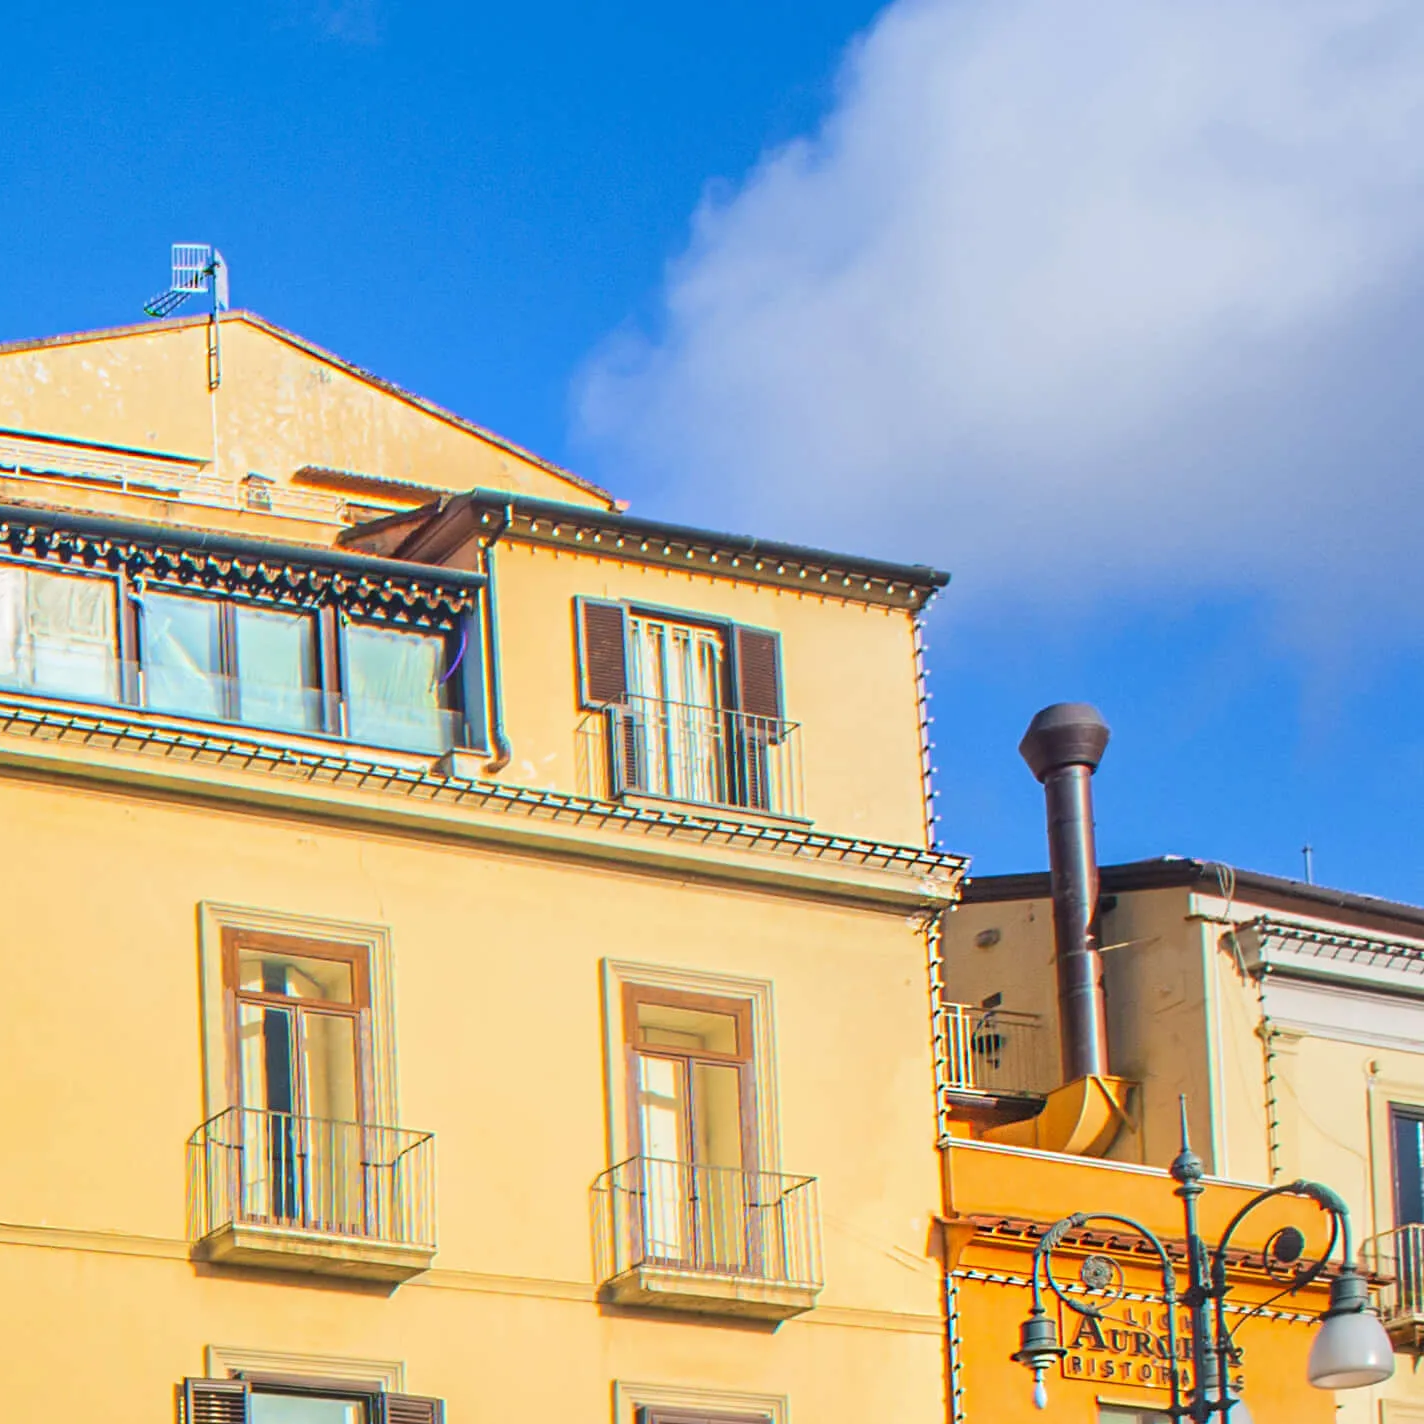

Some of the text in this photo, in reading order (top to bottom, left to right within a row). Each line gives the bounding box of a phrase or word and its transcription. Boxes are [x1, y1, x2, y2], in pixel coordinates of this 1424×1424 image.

[1126, 1306, 1194, 1330] LIGH
[1068, 1315, 1246, 1367] AURO
[1070, 1356, 1244, 1393] RISTORAE
